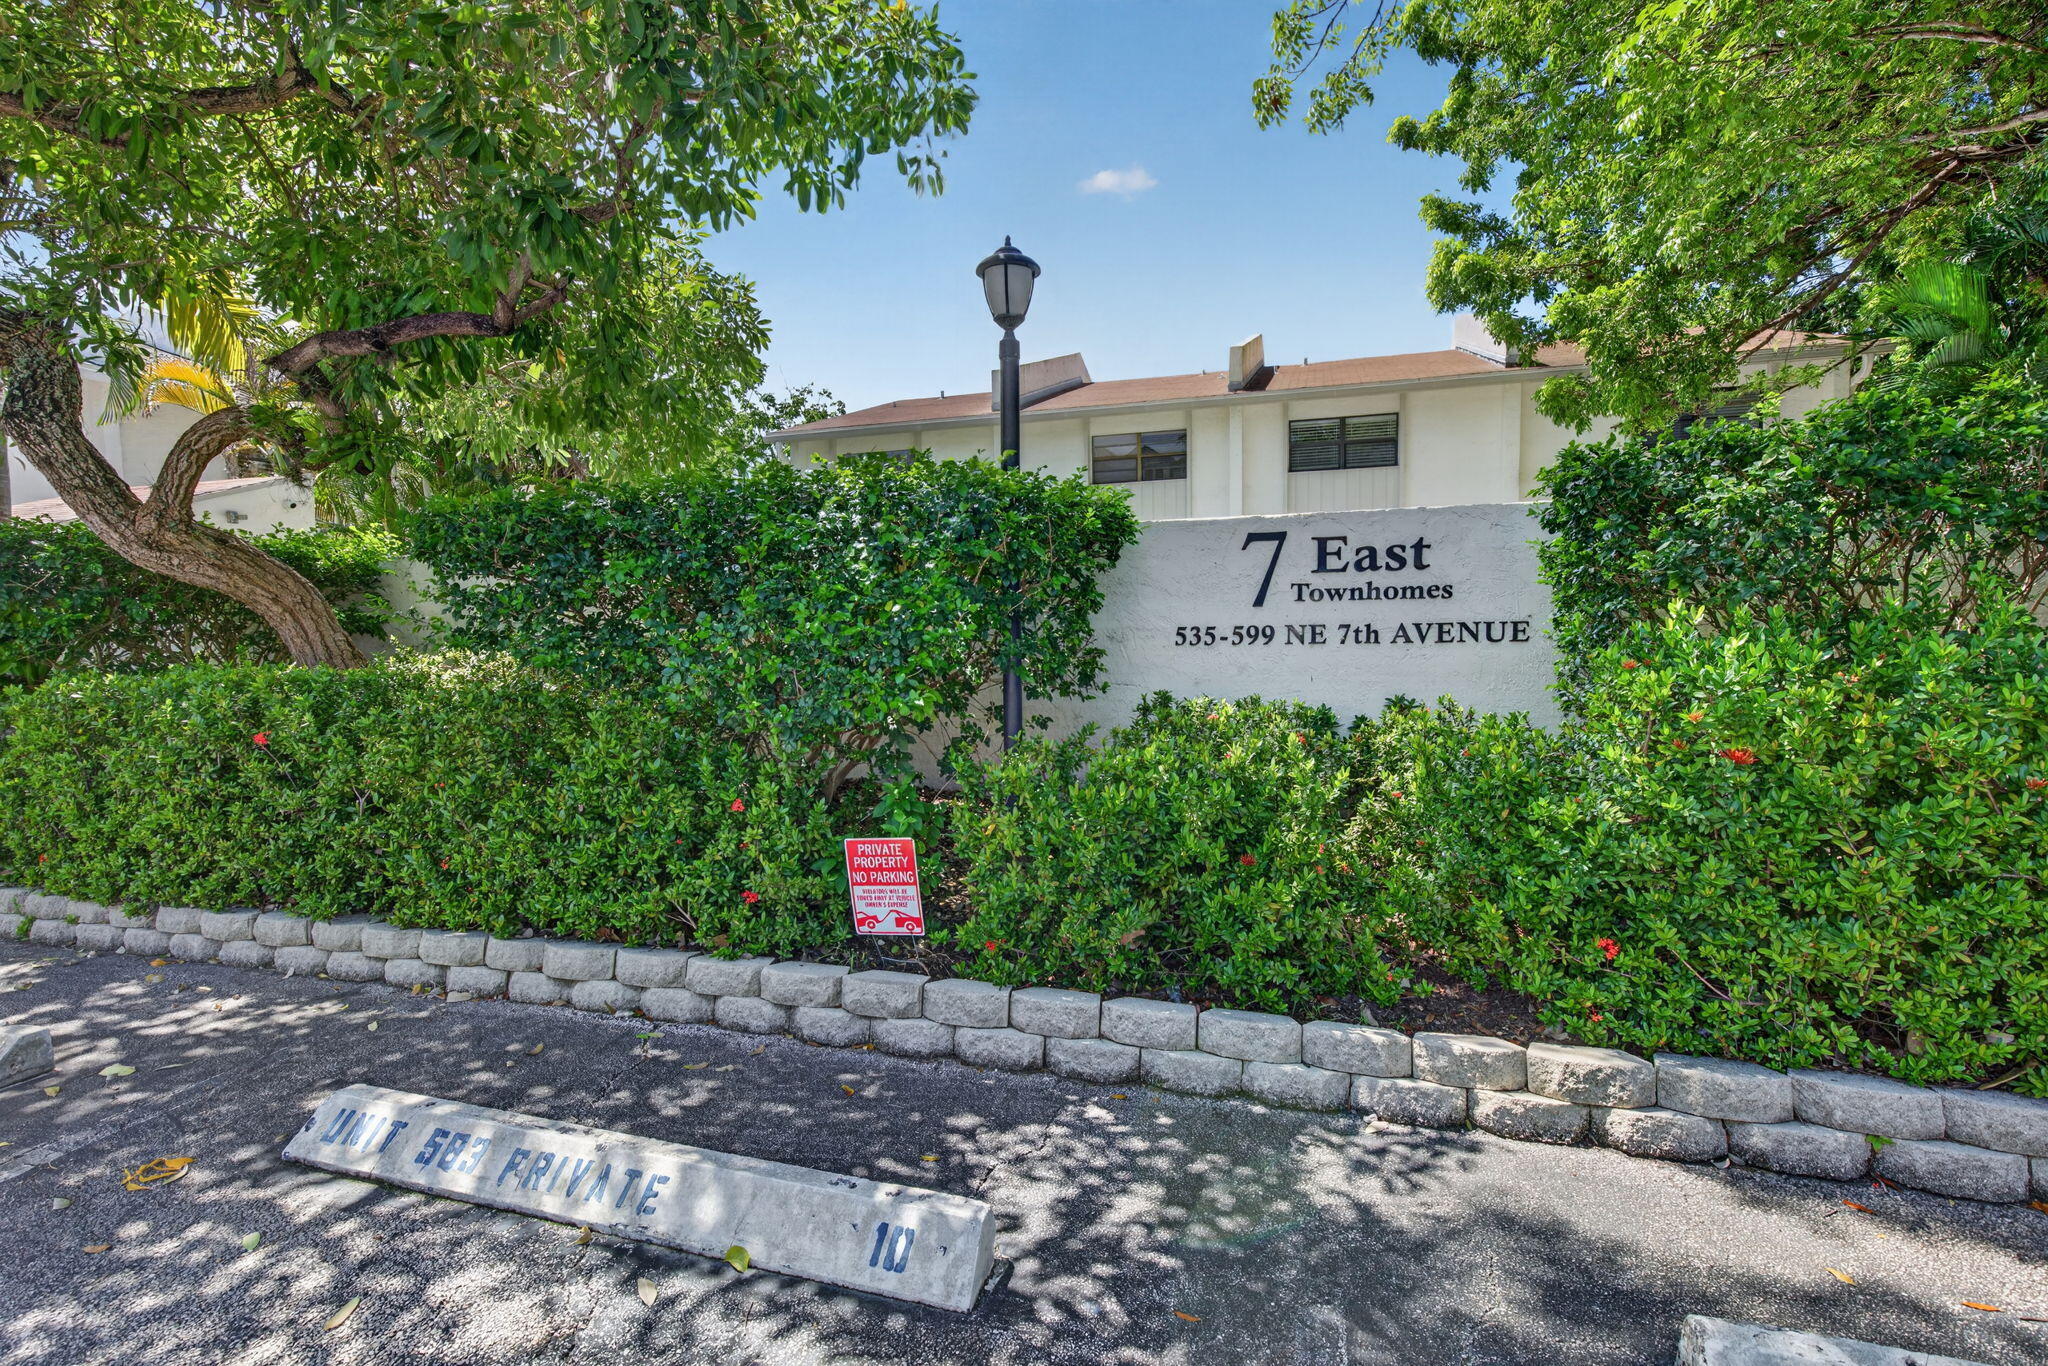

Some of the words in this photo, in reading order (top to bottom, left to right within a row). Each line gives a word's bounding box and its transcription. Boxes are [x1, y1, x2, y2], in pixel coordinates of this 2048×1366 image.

[1241, 530, 1288, 608] 7
[1310, 536, 1432, 574] East
[1290, 580, 1454, 603] Townhomes
[1174, 625, 1276, 647] 535-599
[1284, 624, 1328, 646] NE
[1337, 622, 1381, 645] 7th
[1389, 620, 1531, 645] AVENUE
[853, 856, 909, 868] PROPERTY
[857, 843, 903, 856] PRIVATE
[852, 871, 867, 883] NO
[870, 871, 914, 883] PARKING
[320, 1107, 409, 1154] UNIT
[413, 1127, 492, 1175] 583
[496, 1147, 671, 1217] PRIVATE
[868, 1221, 915, 1274] 10
